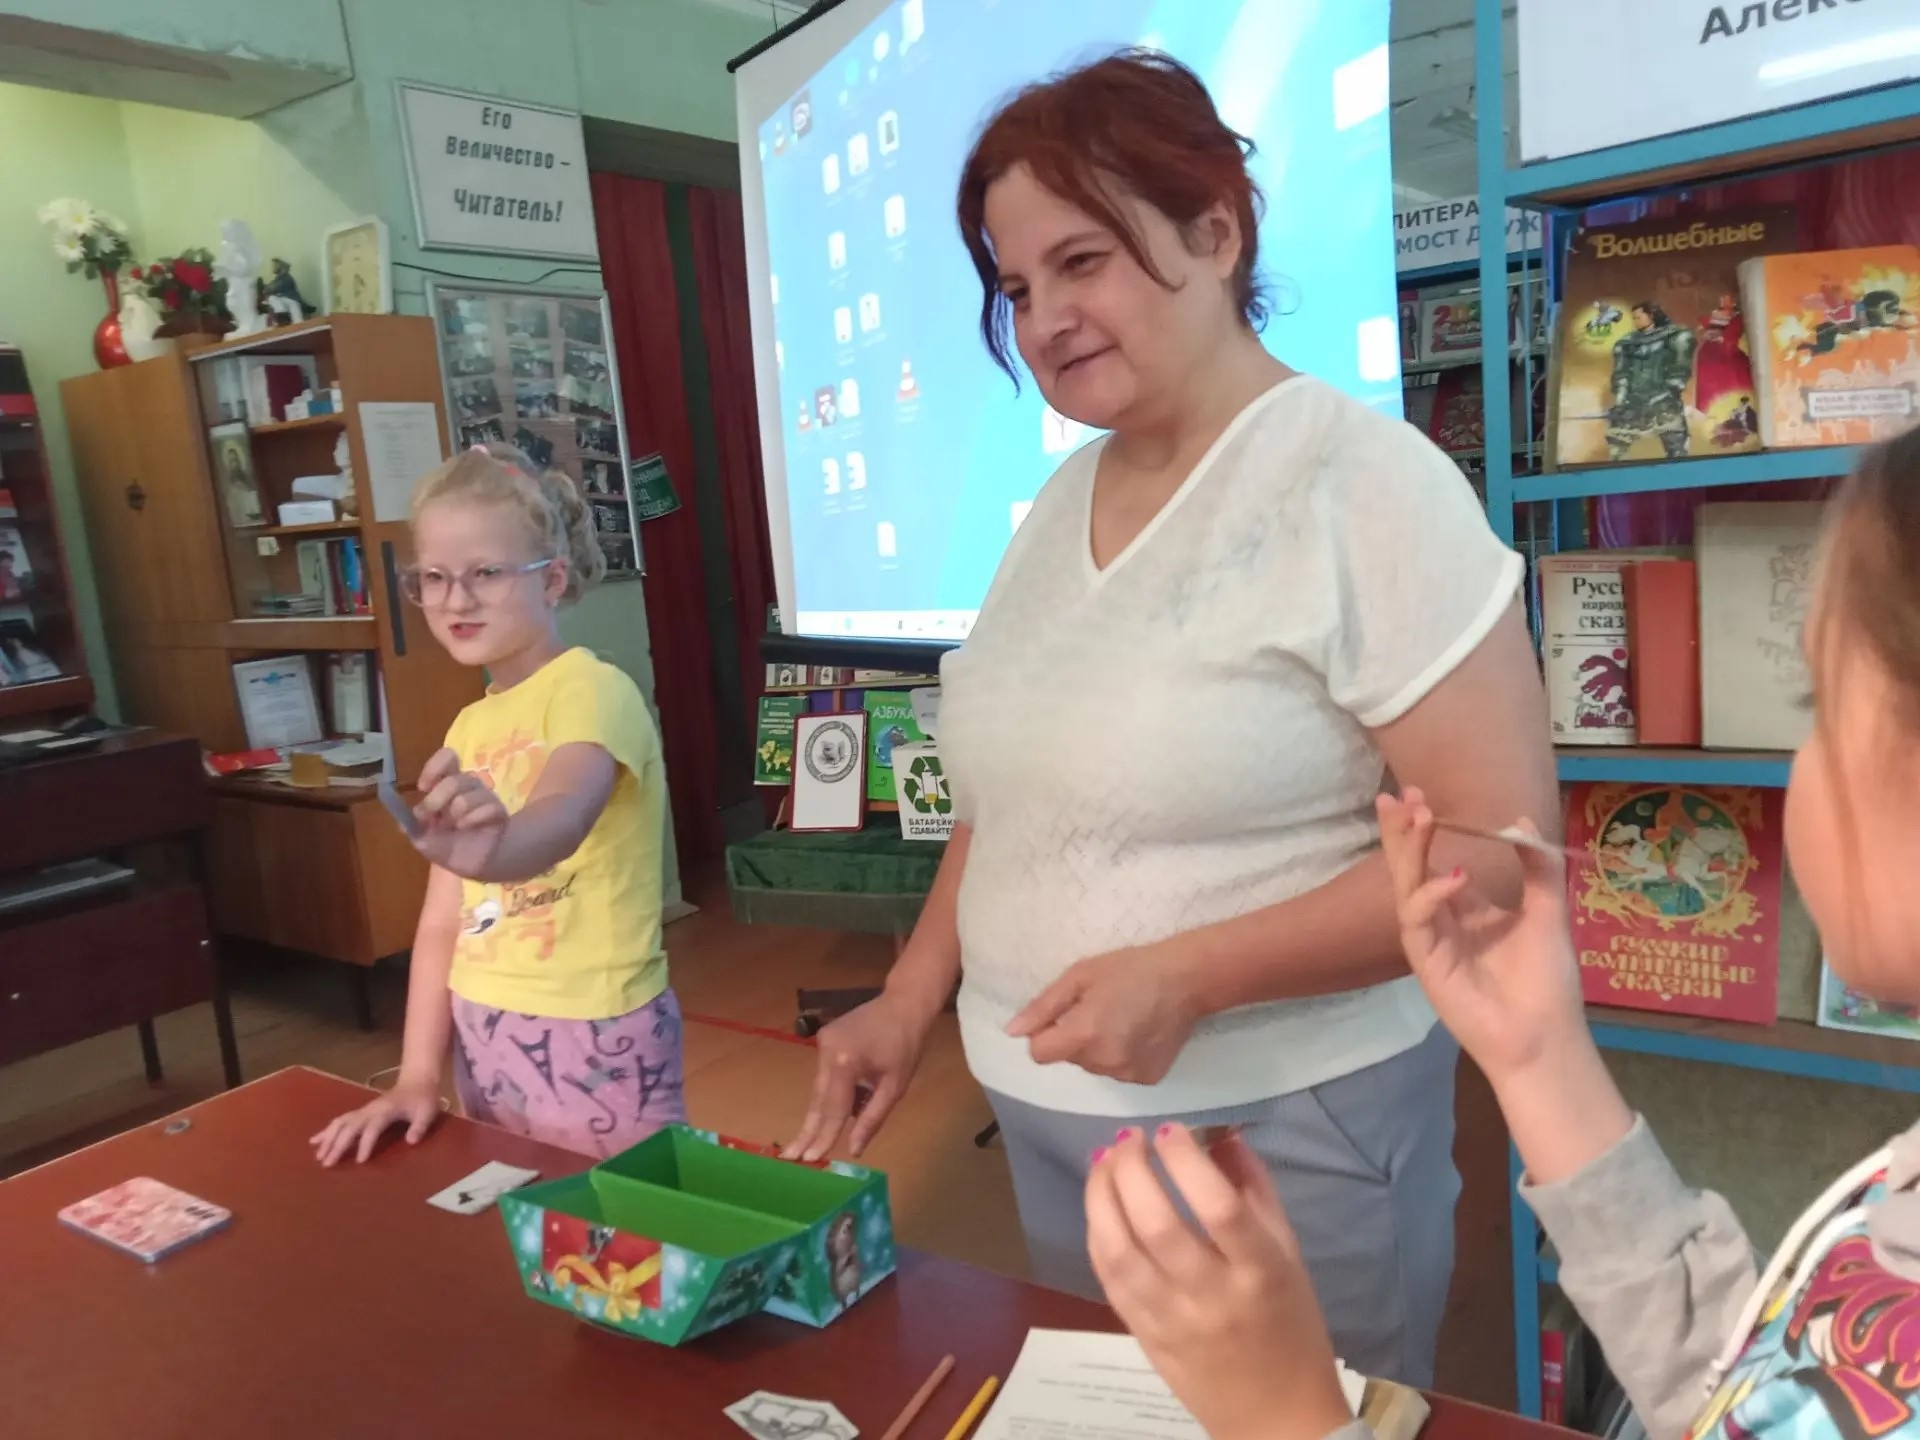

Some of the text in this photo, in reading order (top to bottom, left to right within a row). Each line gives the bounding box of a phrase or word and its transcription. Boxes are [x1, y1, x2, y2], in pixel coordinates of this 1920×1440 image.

[446, 136, 554, 169] Величество
[454, 188, 563, 222] Читатель!
[1397, 229, 1459, 253] МОСТ
[1588, 222, 1765, 259] Волшебные
[1572, 576, 1625, 599] Русс
[872, 706, 916, 719] АЗБУКА
[1608, 971, 1723, 999] СКАЗКИ
